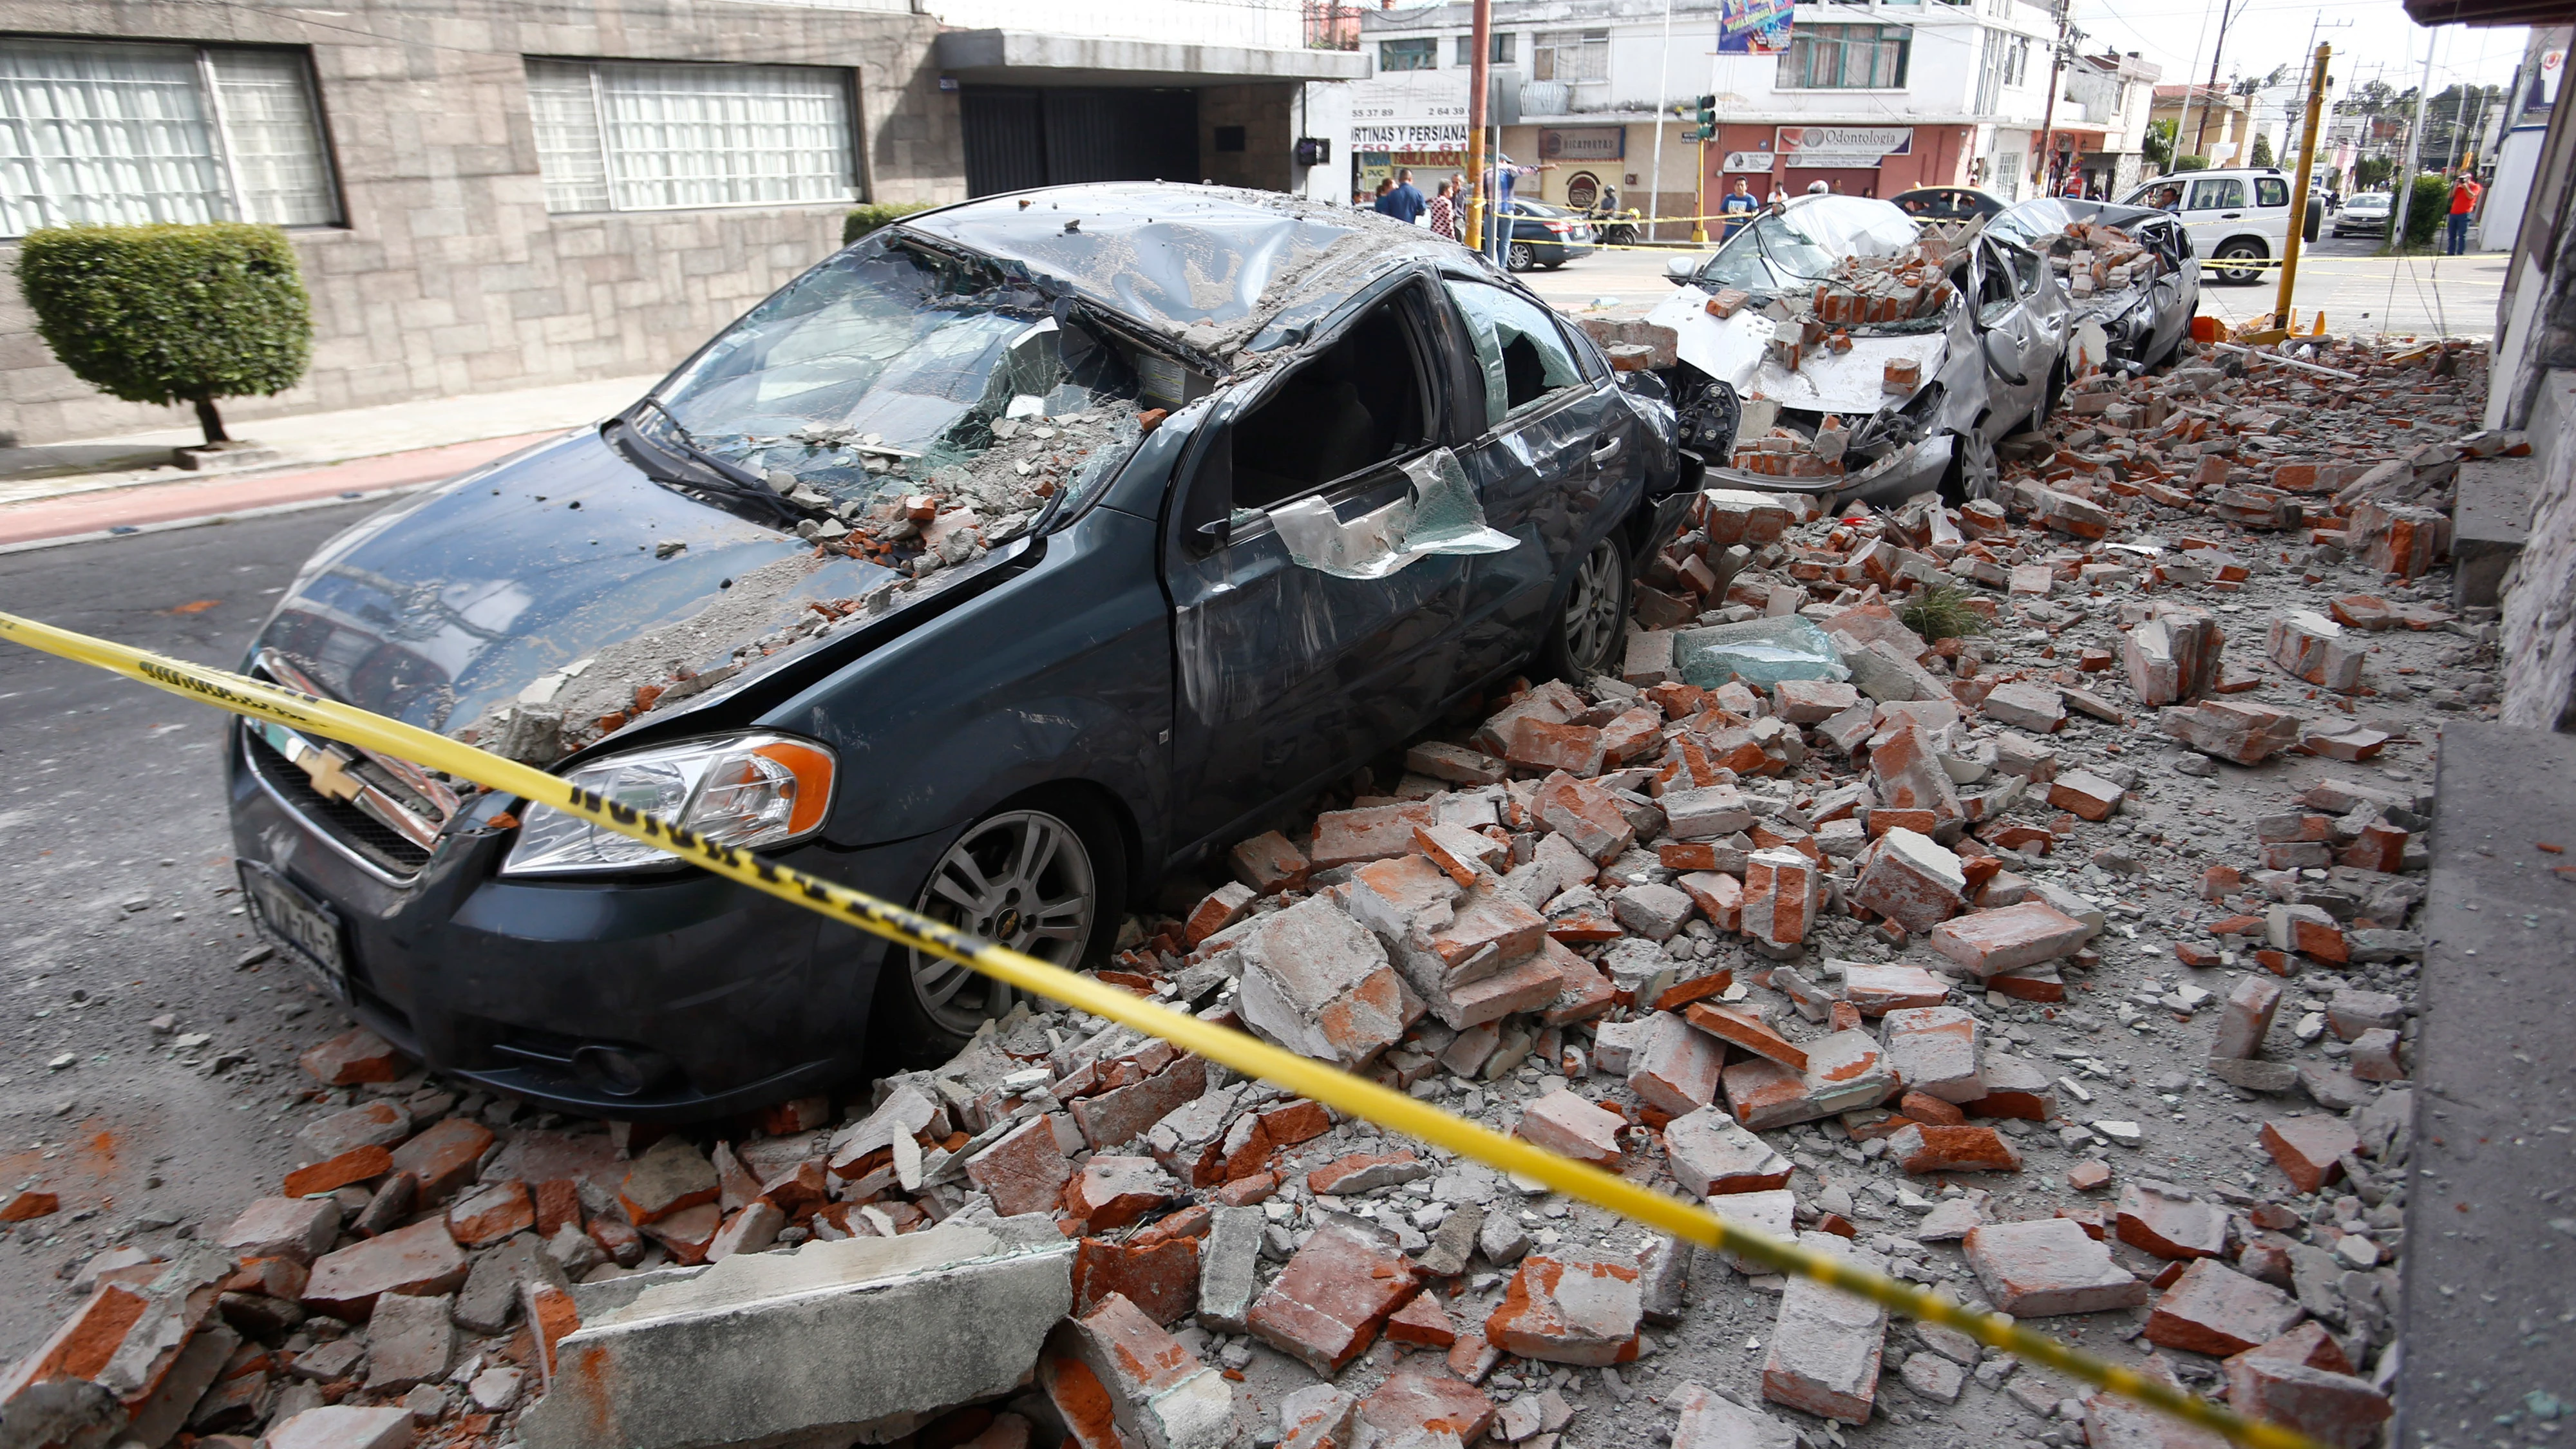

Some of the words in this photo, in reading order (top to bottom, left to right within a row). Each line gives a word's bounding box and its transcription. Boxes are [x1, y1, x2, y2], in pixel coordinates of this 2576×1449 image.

[1381, 108, 1394, 117] 89
[1428, 107, 1434, 115] 2
[1437, 107, 1449, 115] 64
[1453, 106, 1464, 115] 39
[1351, 127, 1394, 142] RTINAS
[1398, 127, 1406, 142] Y
[1409, 126, 1469, 141] PERSIANA
[1398, 143, 1428, 152] 47
[1439, 142, 1466, 152] 61
[1429, 151, 1461, 166] ROCA
